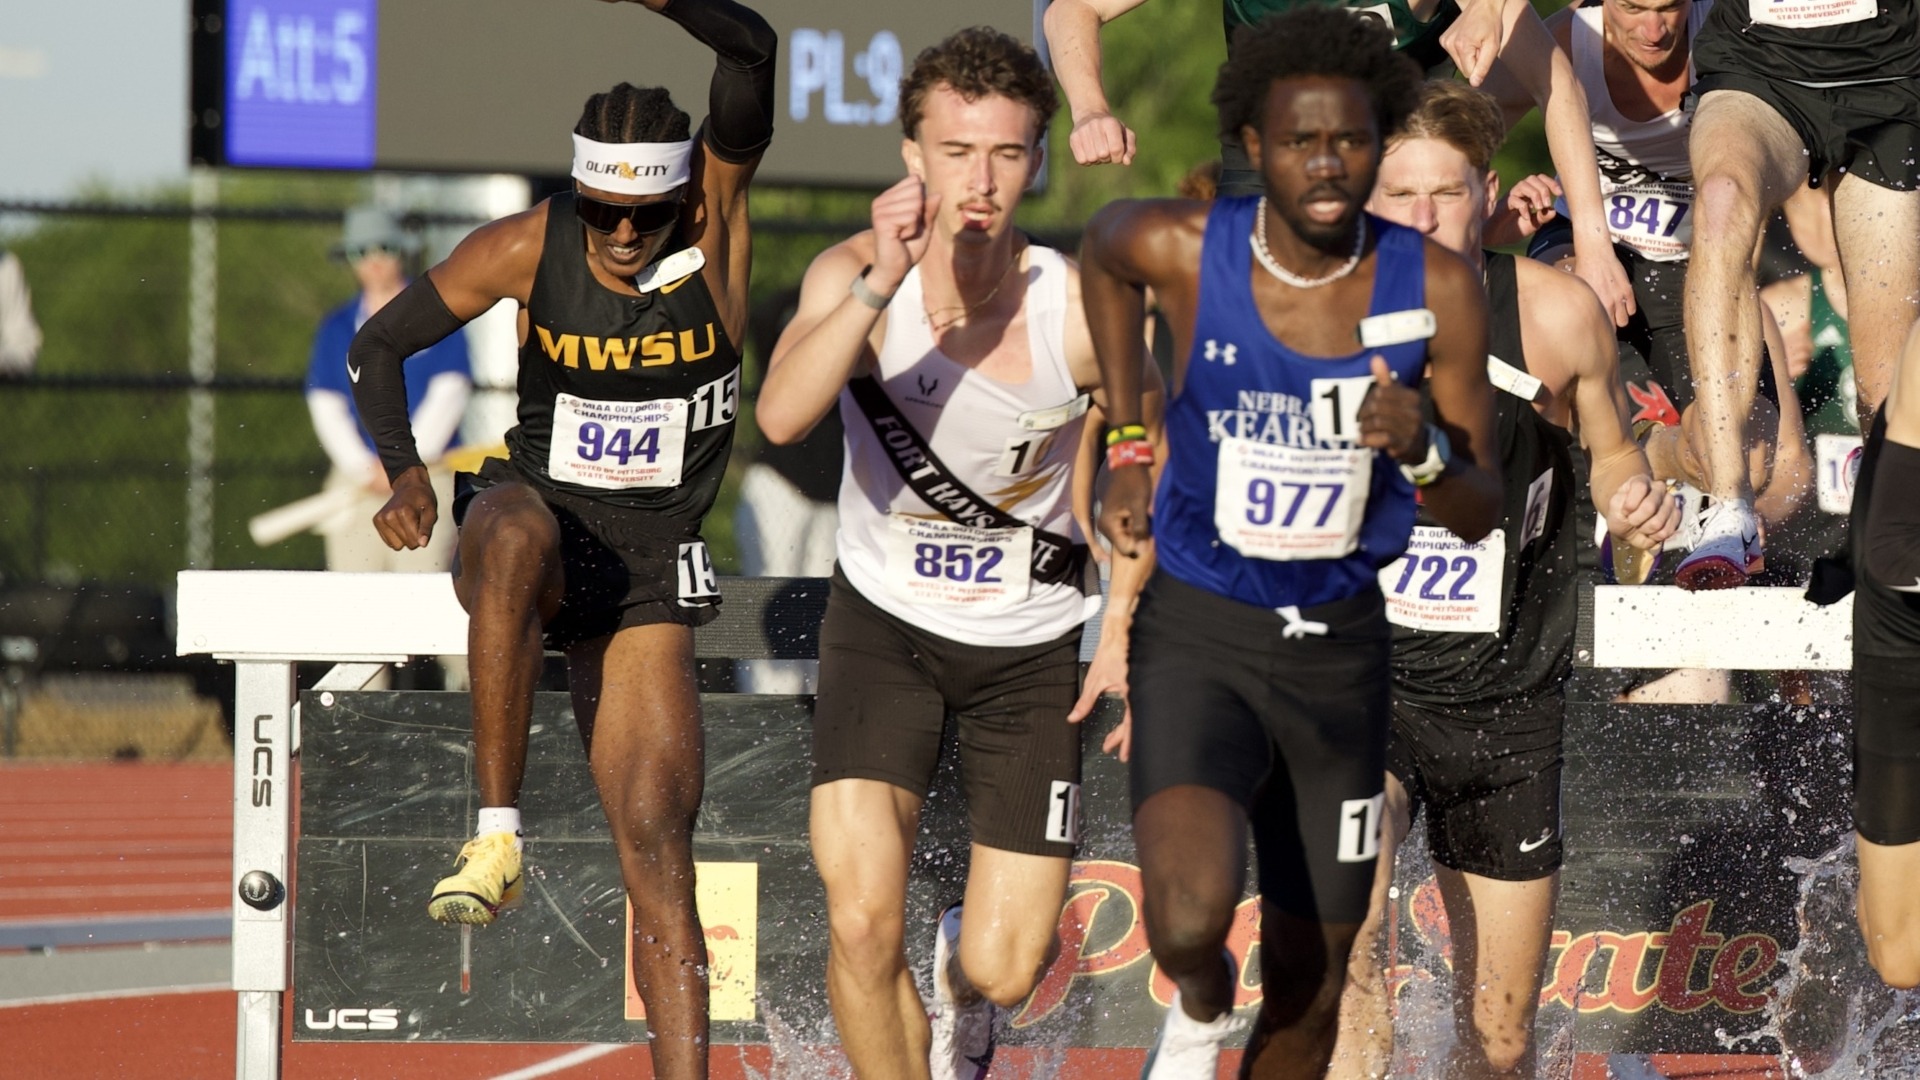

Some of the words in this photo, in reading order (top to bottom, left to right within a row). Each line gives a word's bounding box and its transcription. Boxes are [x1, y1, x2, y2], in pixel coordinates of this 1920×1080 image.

[1803, 8, 1851, 19] UNIVERSITY
[789, 27, 904, 126] PL:9
[585, 160, 618, 175] OUR
[633, 164, 670, 177] CITY
[1609, 194, 1690, 238] 847
[535, 322, 716, 371] MWSU
[573, 408, 670, 423] CHAMPIONSHIPS
[582, 402, 611, 412] MIAA
[614, 402, 661, 413] OUTDOOR
[701, 372, 738, 427] 15
[577, 421, 660, 465] 944
[570, 462, 602, 472] HOSTED
[576, 471, 603, 479] STATE
[605, 474, 654, 483] UNIVERSITY
[875, 415, 940, 480] FORT
[925, 481, 996, 528] HAYS
[1246, 478, 1344, 527] 977
[914, 543, 1004, 583] 852
[1394, 552, 1478, 600] 722
[1386, 597, 1417, 610] HOSTED
[1393, 606, 1418, 618] STATE
[252, 714, 273, 808] UCS
[305, 1008, 399, 1030] UCS
